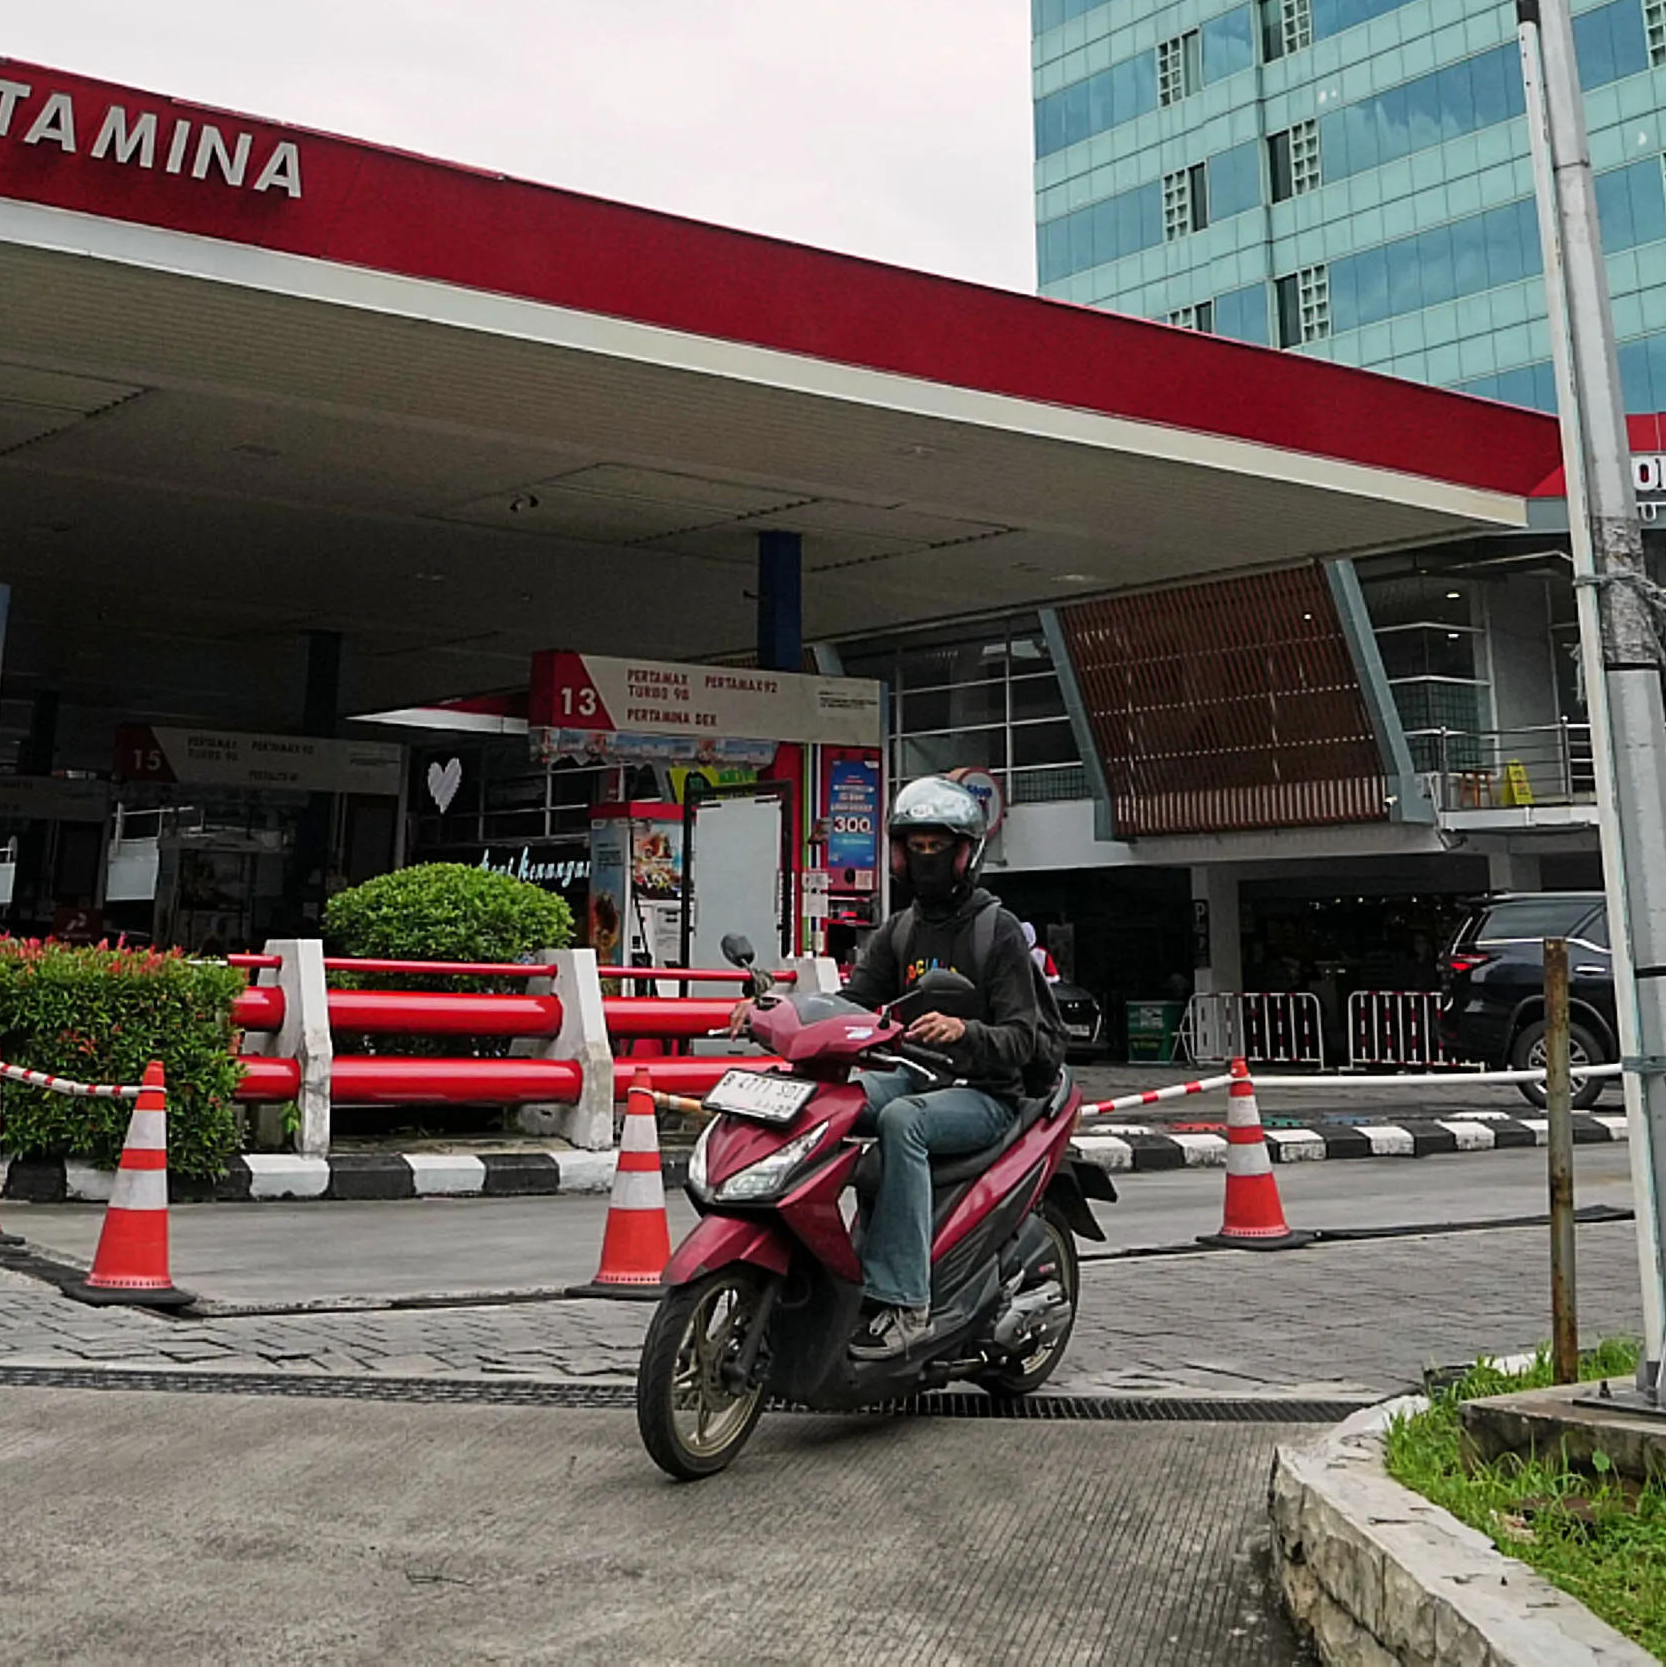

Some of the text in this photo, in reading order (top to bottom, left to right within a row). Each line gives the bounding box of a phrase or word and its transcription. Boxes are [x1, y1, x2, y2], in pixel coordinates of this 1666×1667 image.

[627, 668, 688, 686] PERTAMAX
[561, 687, 597, 715] 13
[629, 685, 669, 699] TURBO
[627, 708, 717, 727] PERTAMINA DEX
[132, 749, 163, 771] 15
[834, 816, 871, 832] 300
